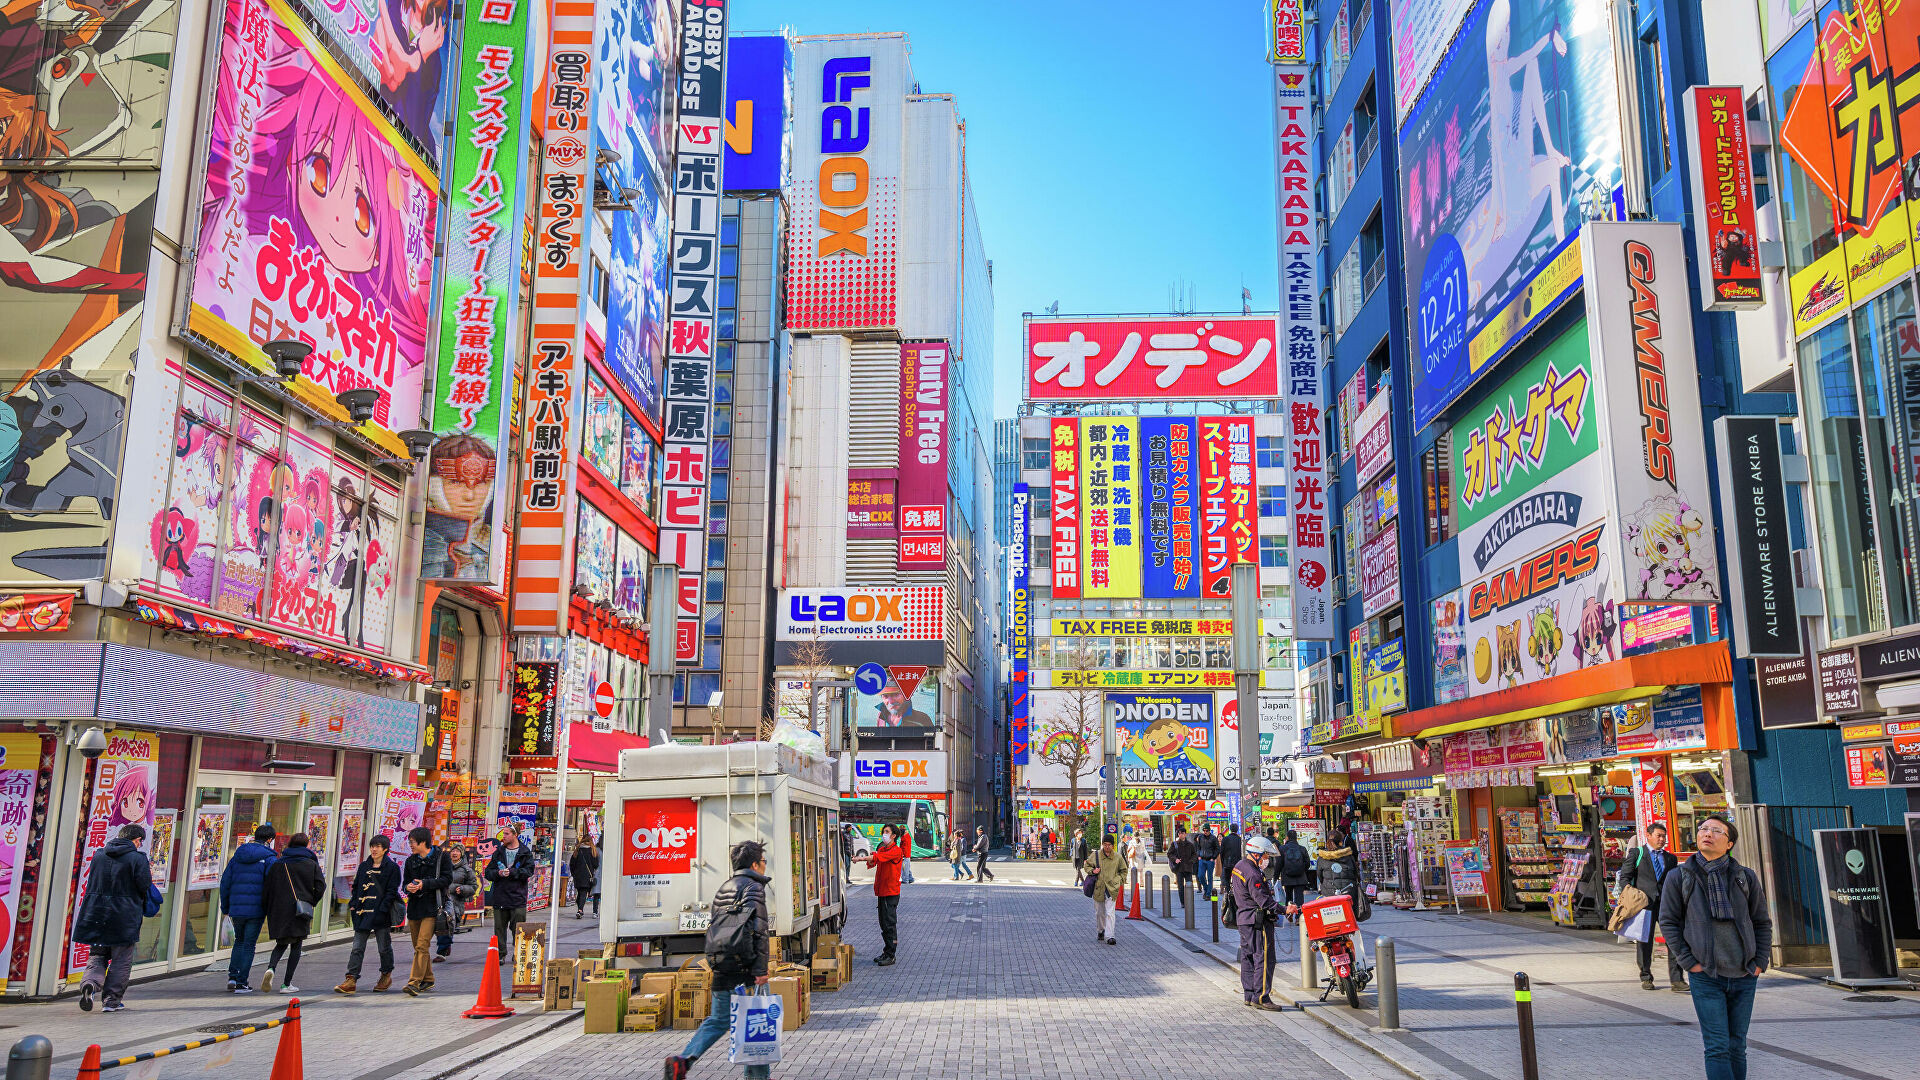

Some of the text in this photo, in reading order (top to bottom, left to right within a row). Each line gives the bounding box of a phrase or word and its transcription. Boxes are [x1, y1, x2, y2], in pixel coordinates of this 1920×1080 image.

[682, 0, 703, 111] ARADISE
[1281, 107, 1310, 244] TAKARADA
[1711, 109, 1739, 226] カードキングダム
[1420, 267, 1461, 348] 12.21
[1033, 322, 1272, 388] オノデン
[1289, 325, 1317, 395] 免税商店
[1426, 323, 1462, 374] ON SALE
[1624, 240, 1677, 492] GAMERS
[530, 344, 567, 508] アキバ駅前店
[903, 350, 917, 437] Flagship Store
[917, 350, 945, 464] Duty Free
[1054, 425, 1075, 471] 免税
[904, 510, 941, 527] 免税
[1055, 475, 1076, 587] TAX FREE
[1150, 435, 1169, 567] お見積り無料です
[1483, 494, 1567, 560] AKIHABARA
[903, 542, 941, 556] 면세점
[1370, 547, 1396, 578] COMPUTER
[1748, 434, 1779, 637] ALIENWARE STORE AKIBA
[1014, 493, 1027, 659] Panasonic ONODEN
[1469, 526, 1603, 618] GAMERS
[789, 625, 903, 634] Home Electronics Store
[1060, 620, 1192, 635] TAX FREE 免税店
[1061, 672, 1235, 685] テレビ 冷蔵庫 エアコン 特売
[1765, 659, 1806, 673] ALIENWARE
[1766, 672, 1807, 686] STORE AKIBA
[1014, 670, 1028, 754] オノデン
[1135, 696, 1172, 704] Welcome
[1260, 713, 1292, 722] Tax-free
[1263, 702, 1292, 711] Japan.
[1272, 722, 1293, 731] Shop
[1118, 768, 1211, 782] KIHABARA
[1125, 800, 1196, 809] オノデン
